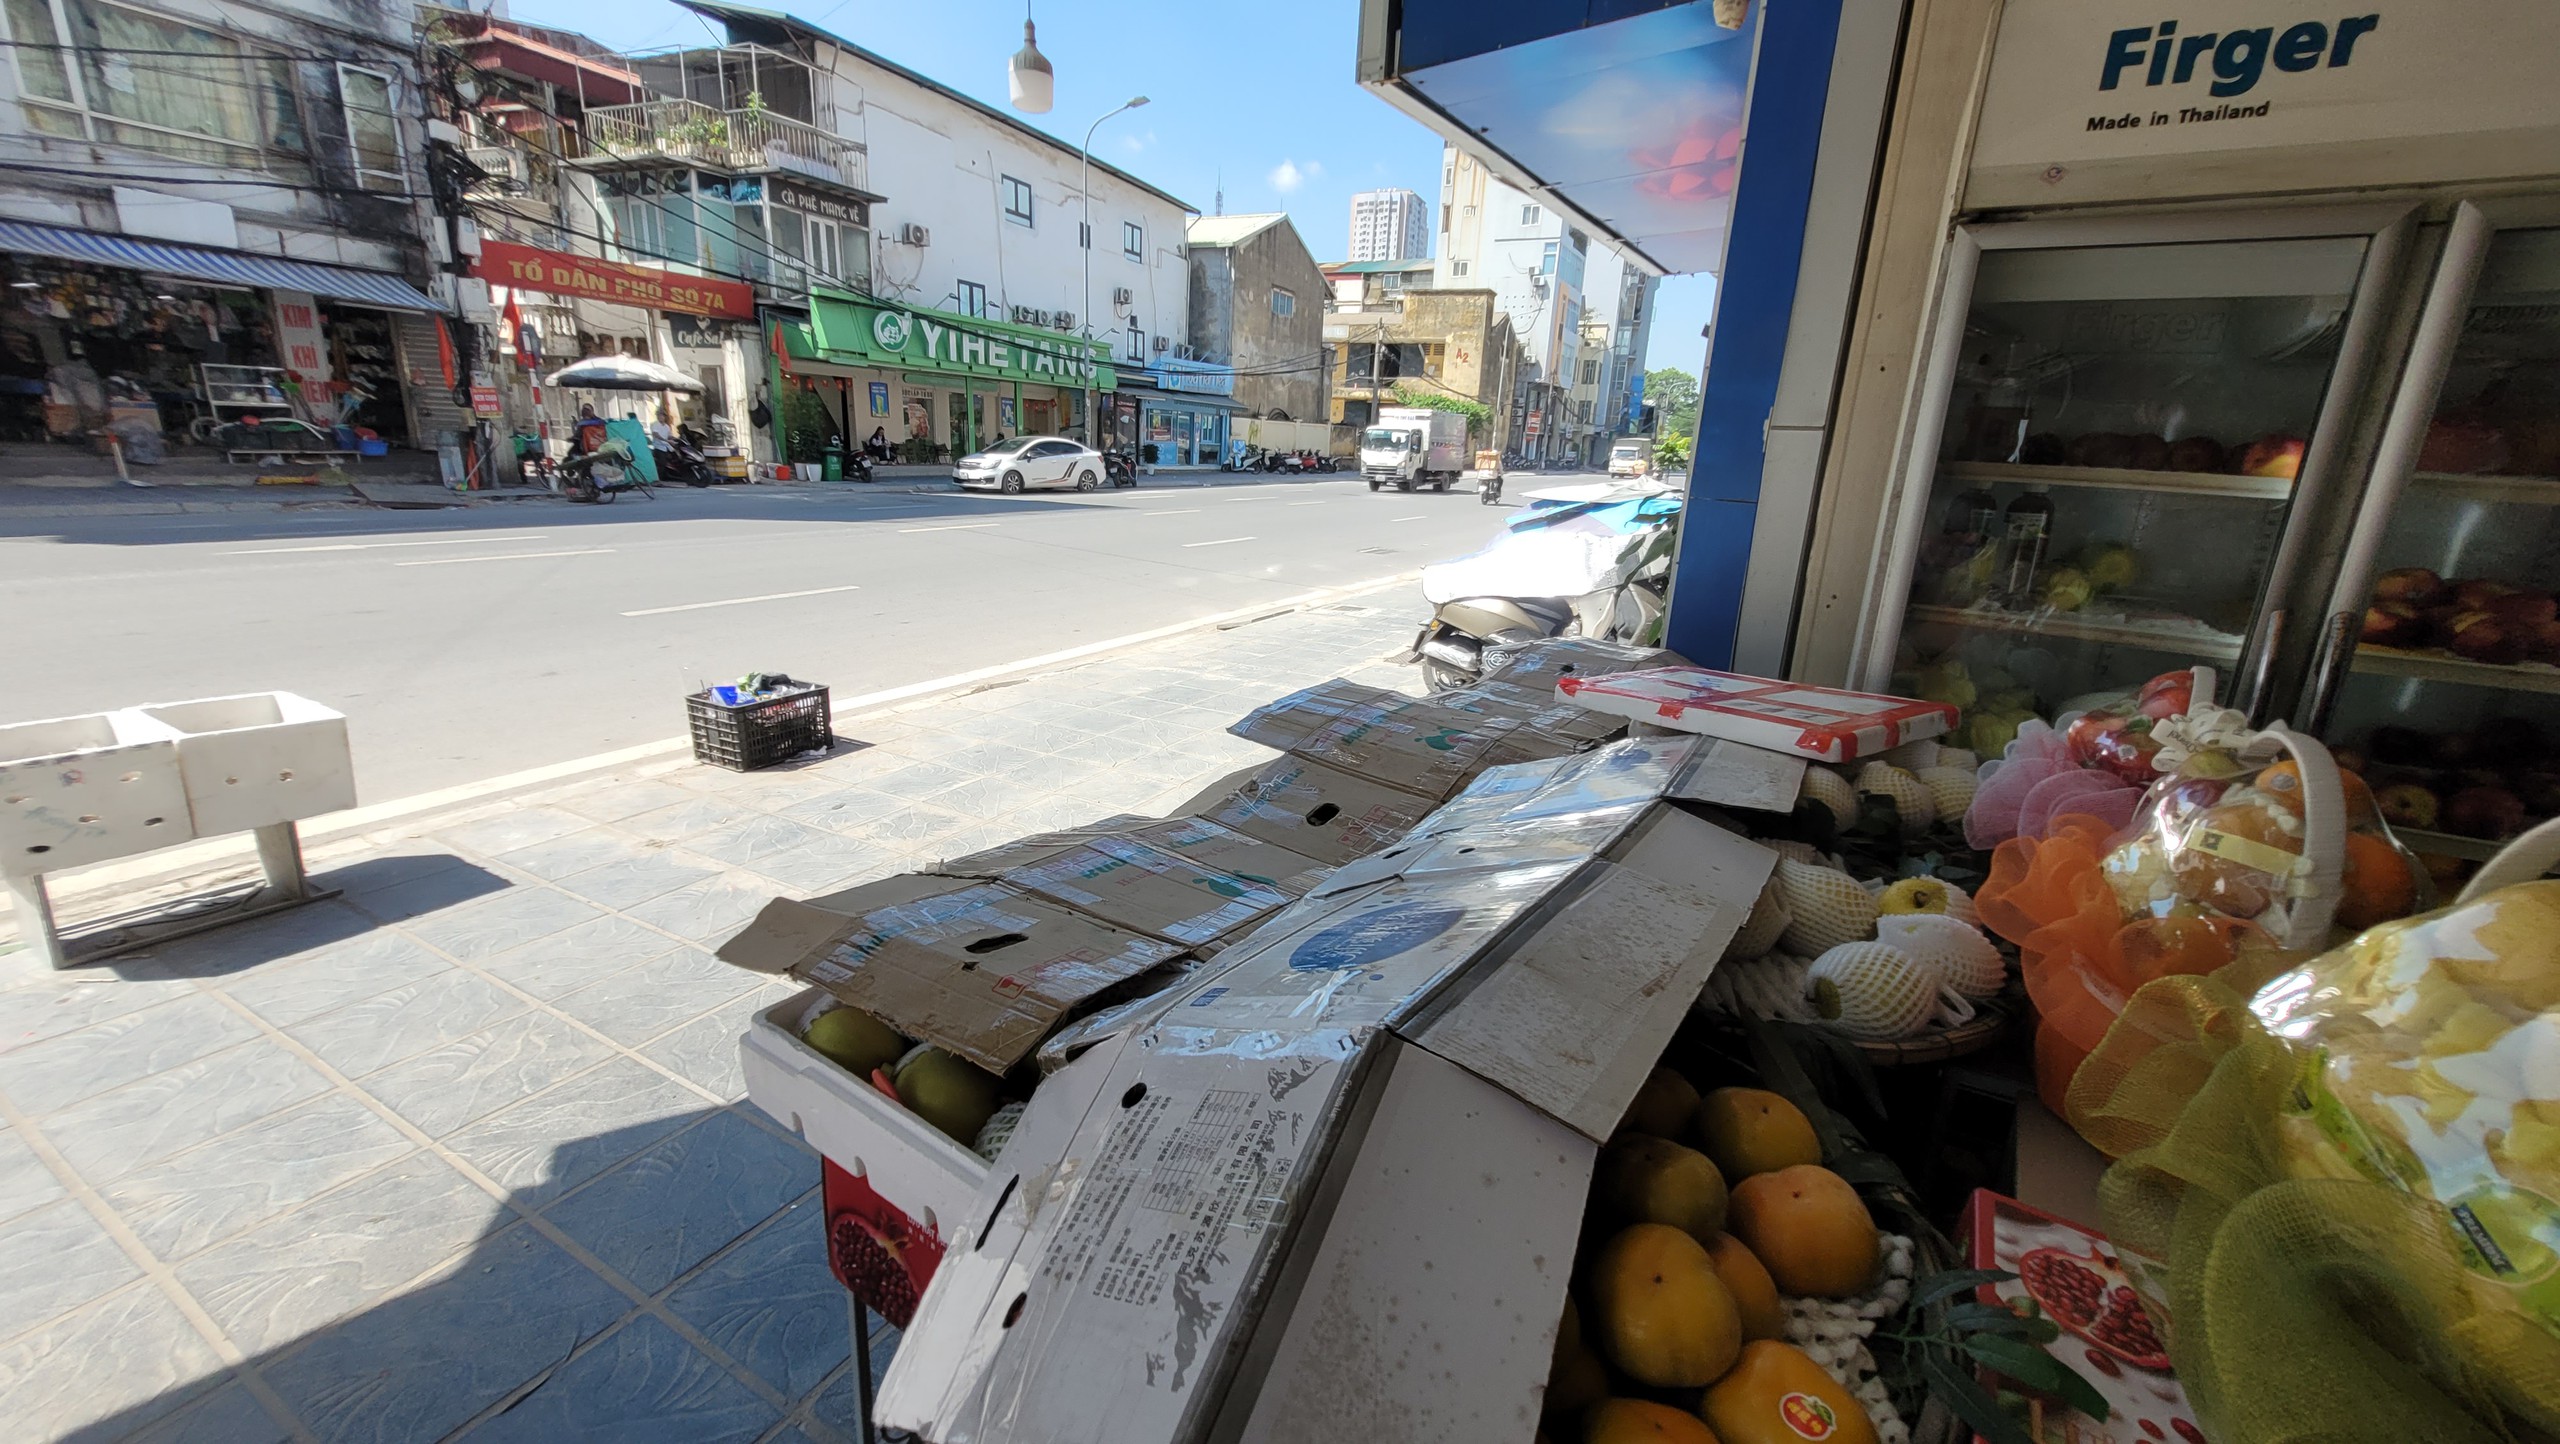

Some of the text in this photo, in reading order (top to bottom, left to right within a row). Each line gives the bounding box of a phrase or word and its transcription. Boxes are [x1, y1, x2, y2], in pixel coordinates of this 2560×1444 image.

[2098, 13, 2380, 98] Firger
[2086, 100, 2271, 132] Made in Thailand
[781, 187, 796, 207] CÀ
[820, 200, 848, 220] MANG
[507, 257, 543, 283] TỔ
[552, 267, 607, 292] DÂN
[614, 274, 664, 300] PHỐ
[670, 284, 699, 304] SỐ
[703, 291, 725, 310] 7A
[280, 303, 313, 328] KIM
[1455, 347, 1469, 364] A2
